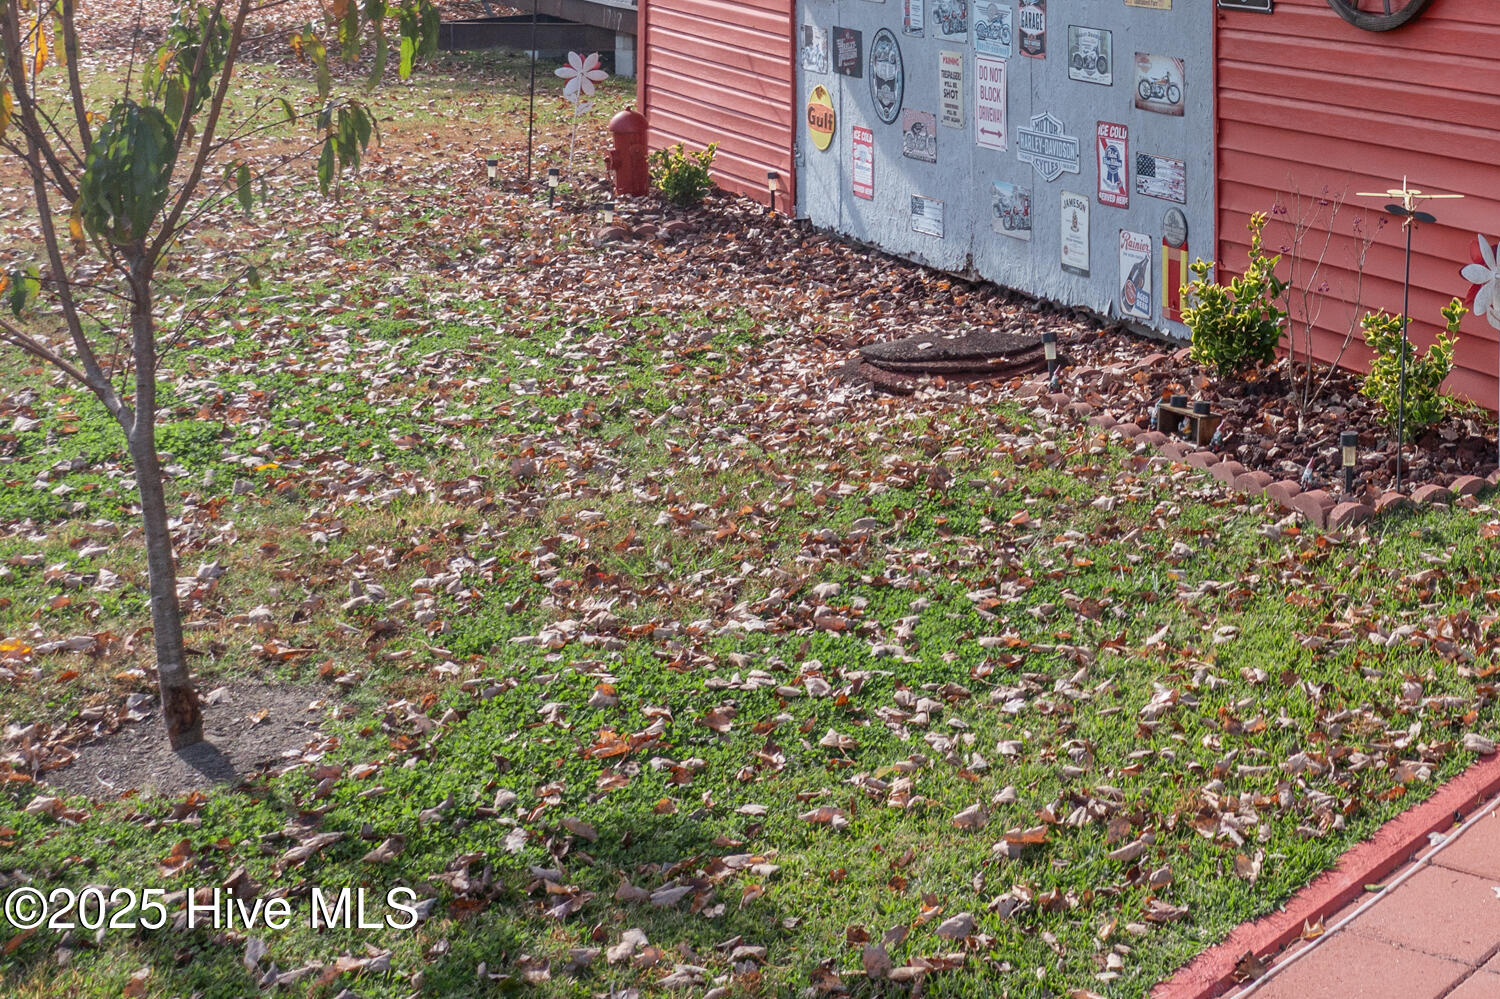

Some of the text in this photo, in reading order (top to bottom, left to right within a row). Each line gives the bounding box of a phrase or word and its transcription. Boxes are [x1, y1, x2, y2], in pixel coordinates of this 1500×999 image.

[1021, 9, 1043, 31] GARAGE
[979, 65, 1003, 84] DO NOT
[943, 88, 959, 100] SHOT
[980, 85, 1001, 103] BLOCK
[807, 106, 833, 131] Gulf
[979, 105, 1003, 124] DRIVEWAY
[1033, 120, 1059, 136] MOTOR
[1098, 125, 1127, 139] ICE COLD
[1019, 133, 1076, 161] HARLEY-DAVIDSON
[1035, 159, 1060, 174] CYCLES
[1062, 199, 1087, 213] JAMESON
[1121, 232, 1151, 253] Rainier
